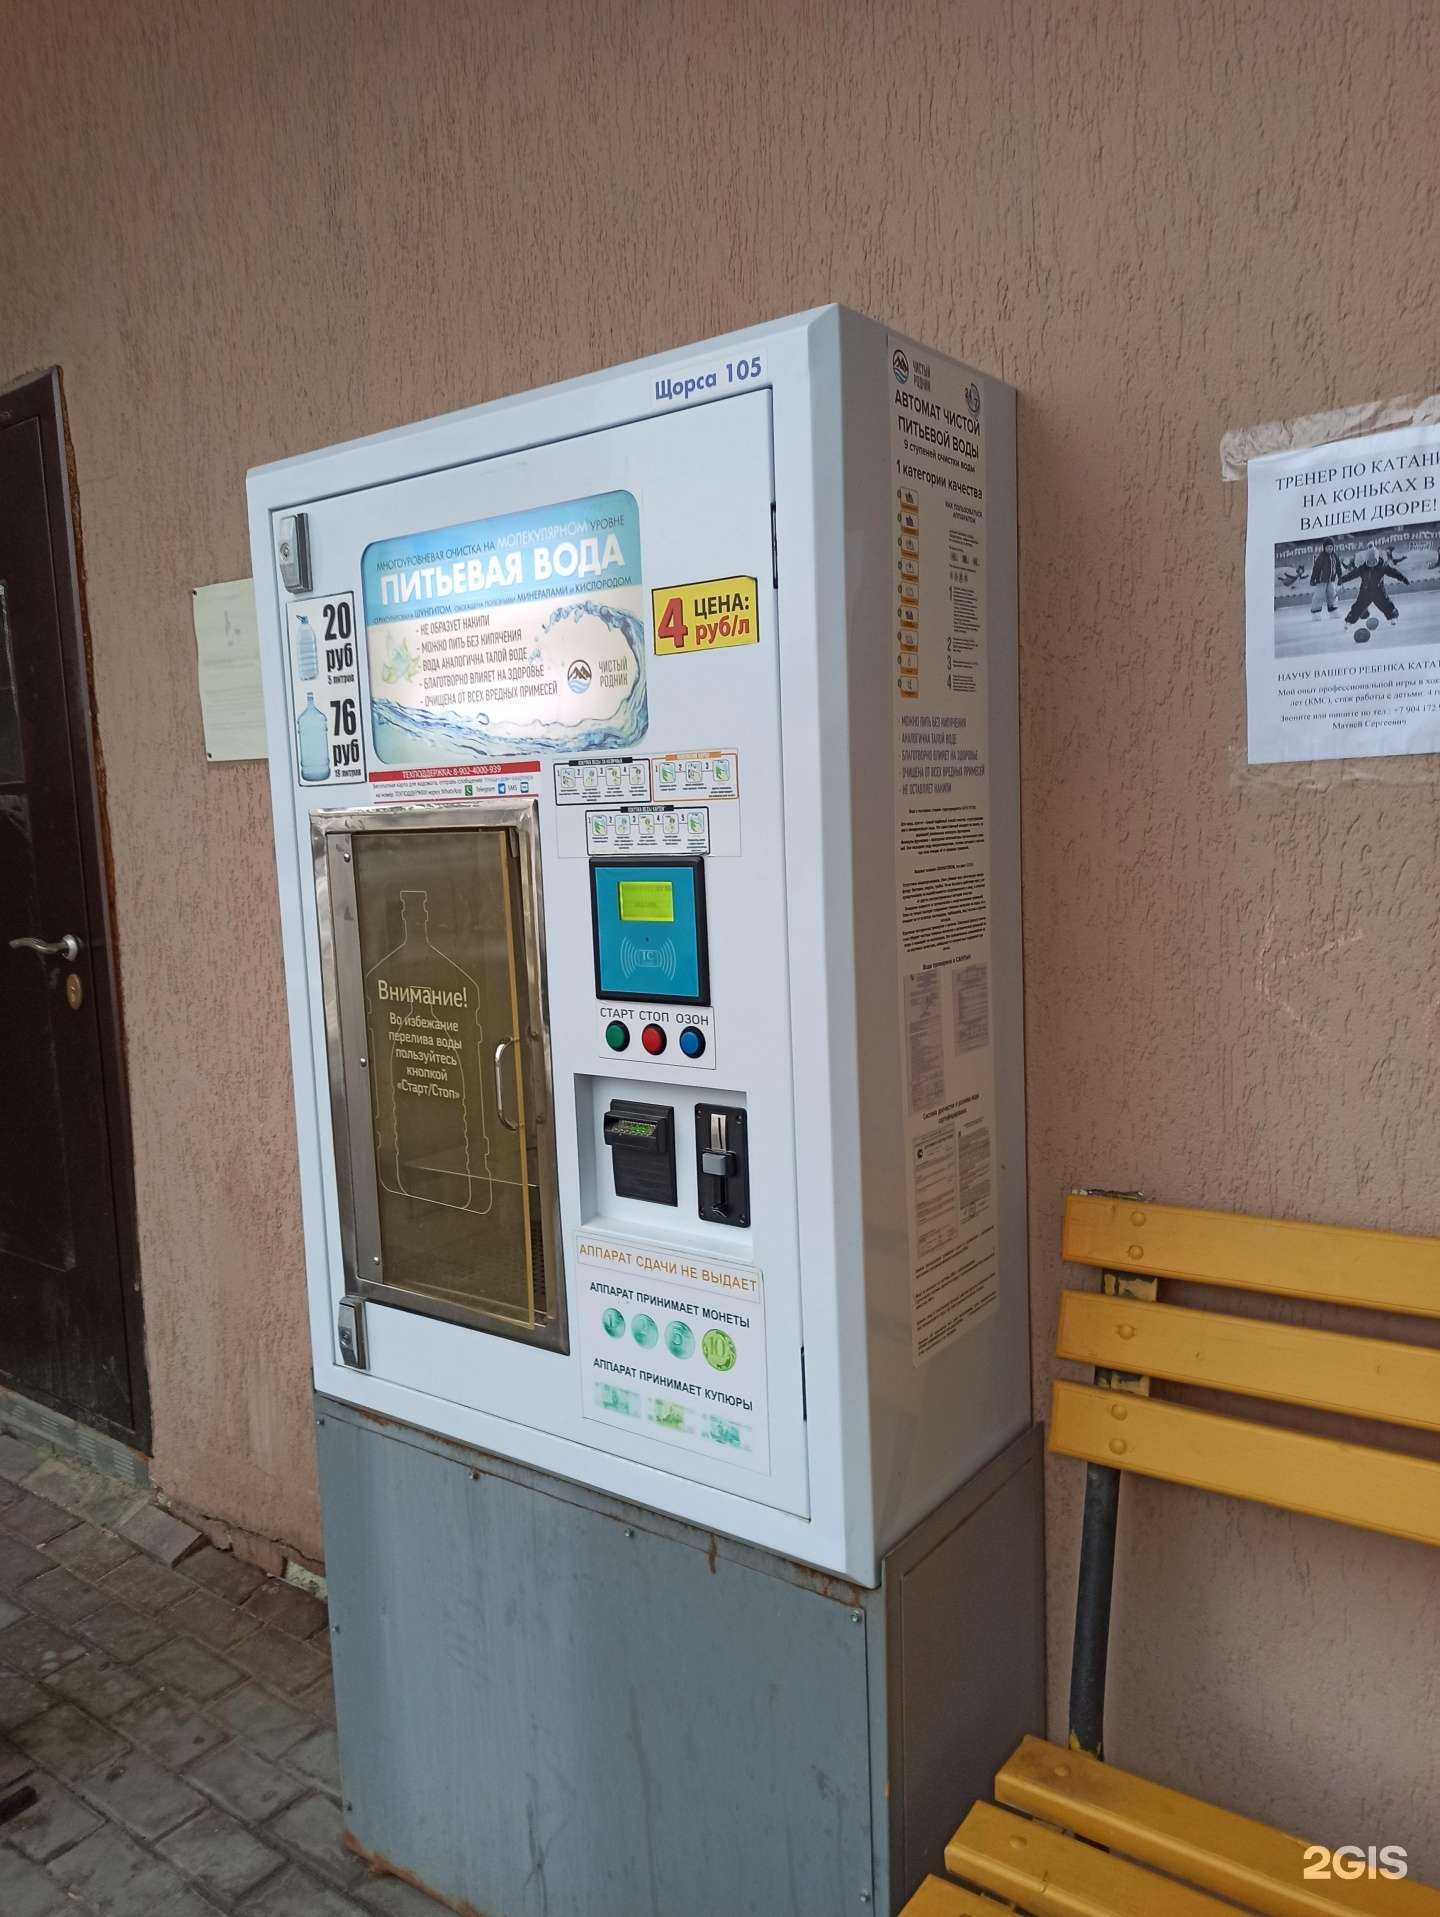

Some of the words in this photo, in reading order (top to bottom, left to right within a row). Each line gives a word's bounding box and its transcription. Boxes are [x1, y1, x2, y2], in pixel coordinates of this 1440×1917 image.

[655, 373, 717, 400] Щорса
[726, 356, 762, 383] 105
[895, 388, 942, 421] АВТОМАТ
[943, 409, 981, 437] ЧИСТОЙ
[898, 415, 951, 449] ПИТЬЕВОЙ
[952, 436, 979, 459] ВОДЫ
[903, 439, 909, 450] 9
[897, 459, 901, 474] 1
[903, 464, 947, 488] категории
[948, 479, 983, 500] качества
[1275, 467, 1338, 491] ТРЕНЕР
[1342, 463, 1366, 479] ПО
[1302, 493, 1327, 508] НА
[1332, 477, 1417, 504] КОНЬКАХ
[1424, 476, 1435, 490] В
[1300, 508, 1366, 531] ВАШЕМ
[1371, 497, 1438, 522] ДВОРЕ!
[376, 549, 444, 572] МНОГОУРОВНЕВАЯ
[446, 544, 481, 560] ОЧИСТКА
[480, 541, 496, 553] НА
[498, 522, 589, 548] МОЛЕКУЛЯРНОМ
[590, 514, 625, 532] УРОВНЕ
[381, 548, 525, 606] ПИТЬЕВАЯ
[533, 533, 626, 581] ВОДА
[517, 585, 569, 602] МИНЕРАЛАМИ
[575, 576, 633, 594] КИСЛОРОДОМ
[322, 601, 352, 642] 20
[420, 618, 431, 636] НЕ
[430, 618, 462, 634] ОБРАЗУЕТ
[463, 614, 490, 630] НАКИПИ
[657, 597, 689, 648] 4
[694, 592, 750, 620] ЦЕНА:
[695, 614, 750, 646] руб/л
[421, 638, 447, 654] МОЖНО
[448, 636, 466, 652] ПИТЬ
[466, 634, 480, 649] БЕЗ
[480, 628, 522, 646] КИПЯЧЕНИЯ
[326, 642, 354, 673] руб
[422, 658, 441, 672] ВОДА
[441, 653, 485, 670] АНАЛОГИЧНА
[485, 648, 508, 664] ТАЛОЙ
[508, 646, 529, 662] ВОДЕ
[598, 658, 628, 673] ЧИСТЫЙ
[946, 654, 952, 671] 3
[1278, 671, 1311, 682] НАУЧУ
[1314, 666, 1357, 678] ВАШЕГО
[1359, 663, 1406, 675] РЕБЕНКА
[1408, 659, 1440, 671] КАТА
[327, 674, 333, 685] 5
[333, 673, 355, 684] литров
[423, 672, 469, 690] БЛАГОТВОРНО
[469, 669, 495, 685] ВЛИЯЕТ
[497, 669, 507, 680] НА
[507, 664, 545, 681] ЗДОРОВЬЕ
[600, 674, 629, 688] РОДНИК
[424, 692, 457, 708] ОЧИЩЕНА
[457, 692, 467, 703] ОТ
[467, 689, 484, 703] ВСЕХ
[485, 687, 519, 702] ВРЕДНЫХ
[519, 680, 558, 697] ПРИМЕСЕЙ
[329, 698, 357, 737] 76
[332, 738, 360, 767] руб
[341, 768, 362, 778] литров
[453, 764, 502, 776] 8-902-4000-939
[641, 950, 655, 961] IC
[377, 979, 468, 1009] Внимание!
[389, 1011, 403, 1026] Во
[404, 1014, 459, 1033] избежание
[600, 1007, 635, 1020] СТАРТ
[639, 1010, 670, 1023] СТОП
[675, 1013, 709, 1027] ОЗОН
[388, 1029, 435, 1047] перелива
[435, 1035, 463, 1051] воды
[395, 1047, 458, 1067] пользуйтесь
[406, 1064, 448, 1081] кнопкой
[397, 1079, 461, 1101] «Старт/Стоп»
[579, 1243, 633, 1265] АППАРАТ
[635, 1255, 678, 1274] СДАЧИ
[681, 1264, 698, 1280] НЕ
[701, 1268, 758, 1293] ВЫДАЕТ
[589, 1280, 634, 1301] АППАРАТ
[636, 1292, 700, 1316] ПРИНИМАЕТ
[701, 1307, 751, 1329] МОНЕТЫ
[592, 1357, 637, 1379] АППАРАТ
[639, 1369, 702, 1397] ПРИНИМАЕТ
[703, 1387, 754, 1412] КУПЮРЫ
